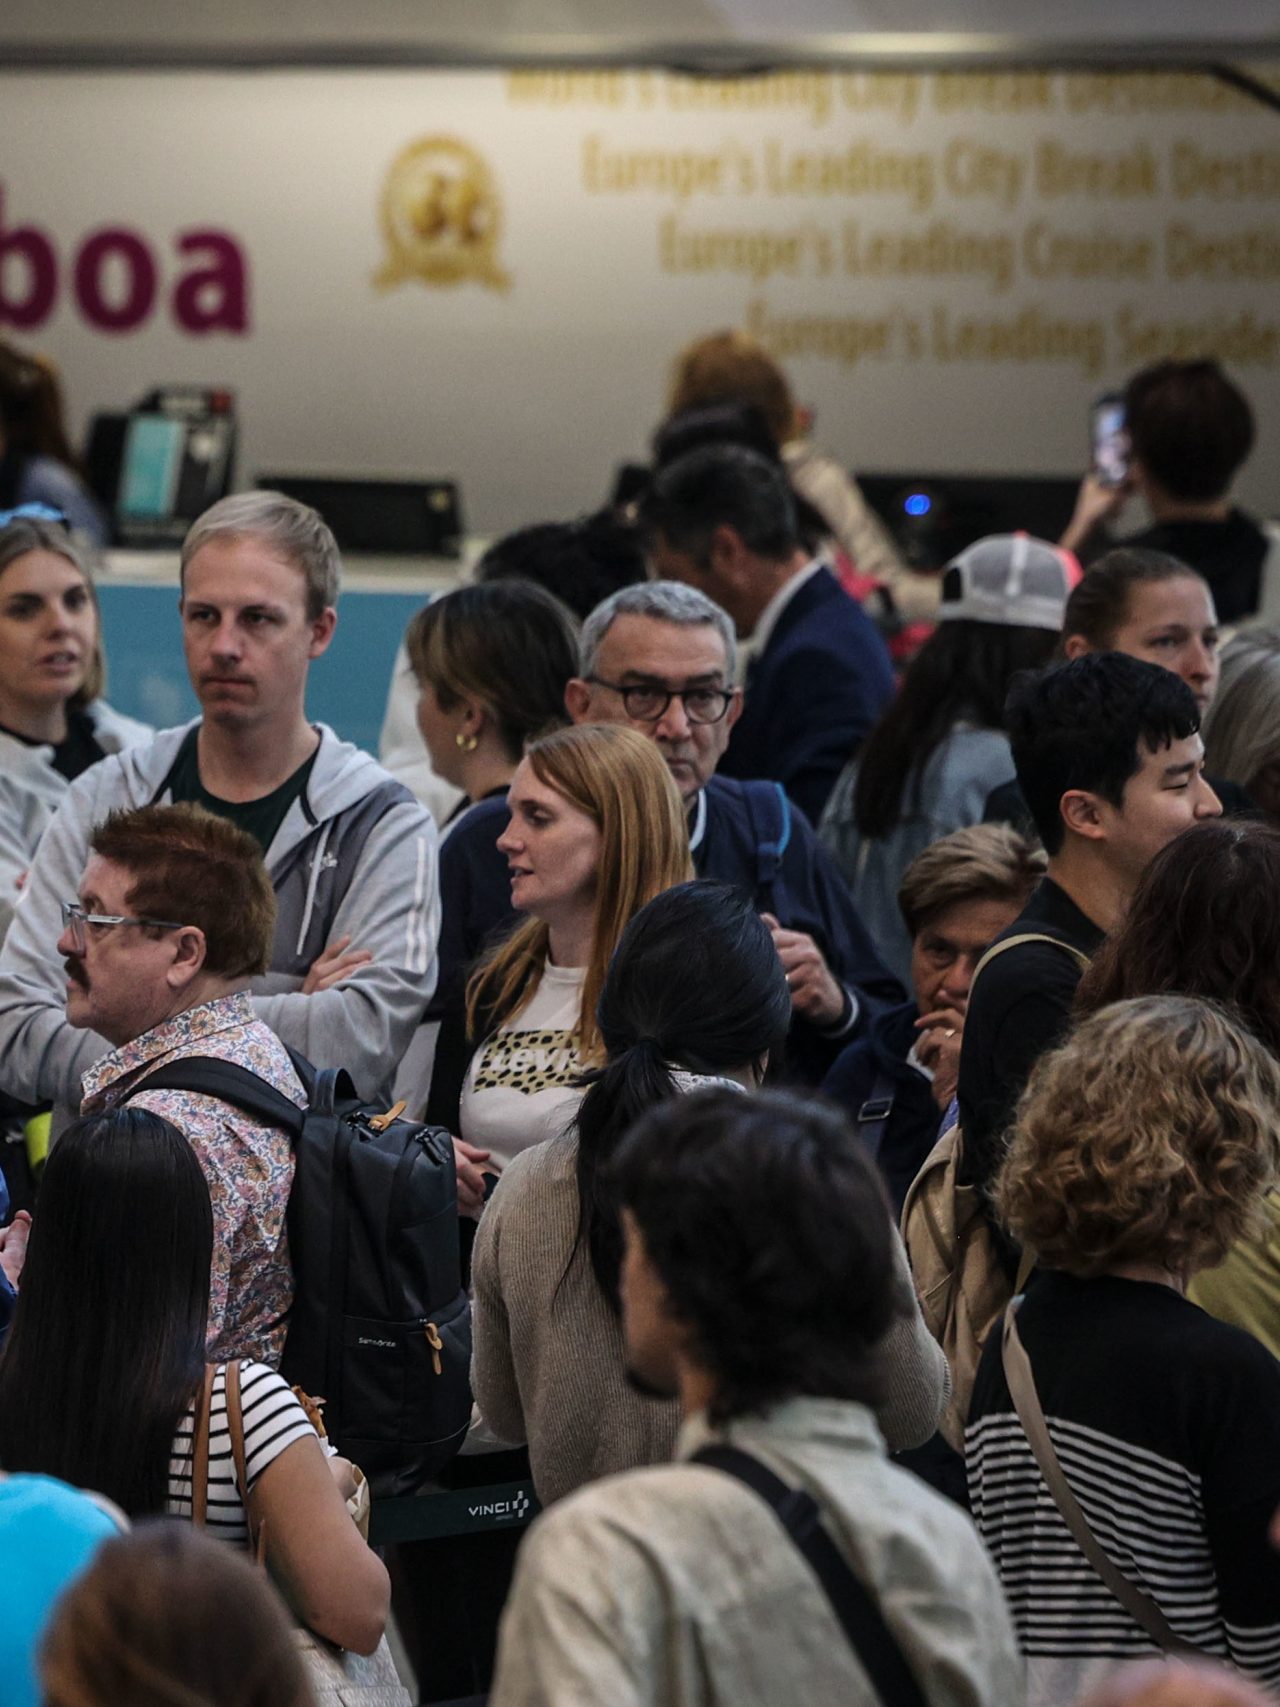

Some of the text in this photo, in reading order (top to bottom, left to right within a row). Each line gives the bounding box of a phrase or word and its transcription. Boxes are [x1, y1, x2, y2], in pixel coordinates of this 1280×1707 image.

[582, 133, 756, 205] Europe's
[762, 134, 933, 212] Leading
[942, 135, 1023, 212] City
[1035, 136, 1157, 197] Break
[658, 215, 834, 285] Europe's
[841, 218, 1014, 293] Leading
[931, 302, 1104, 379] Leading
[468, 1501, 510, 1517] VINCI
